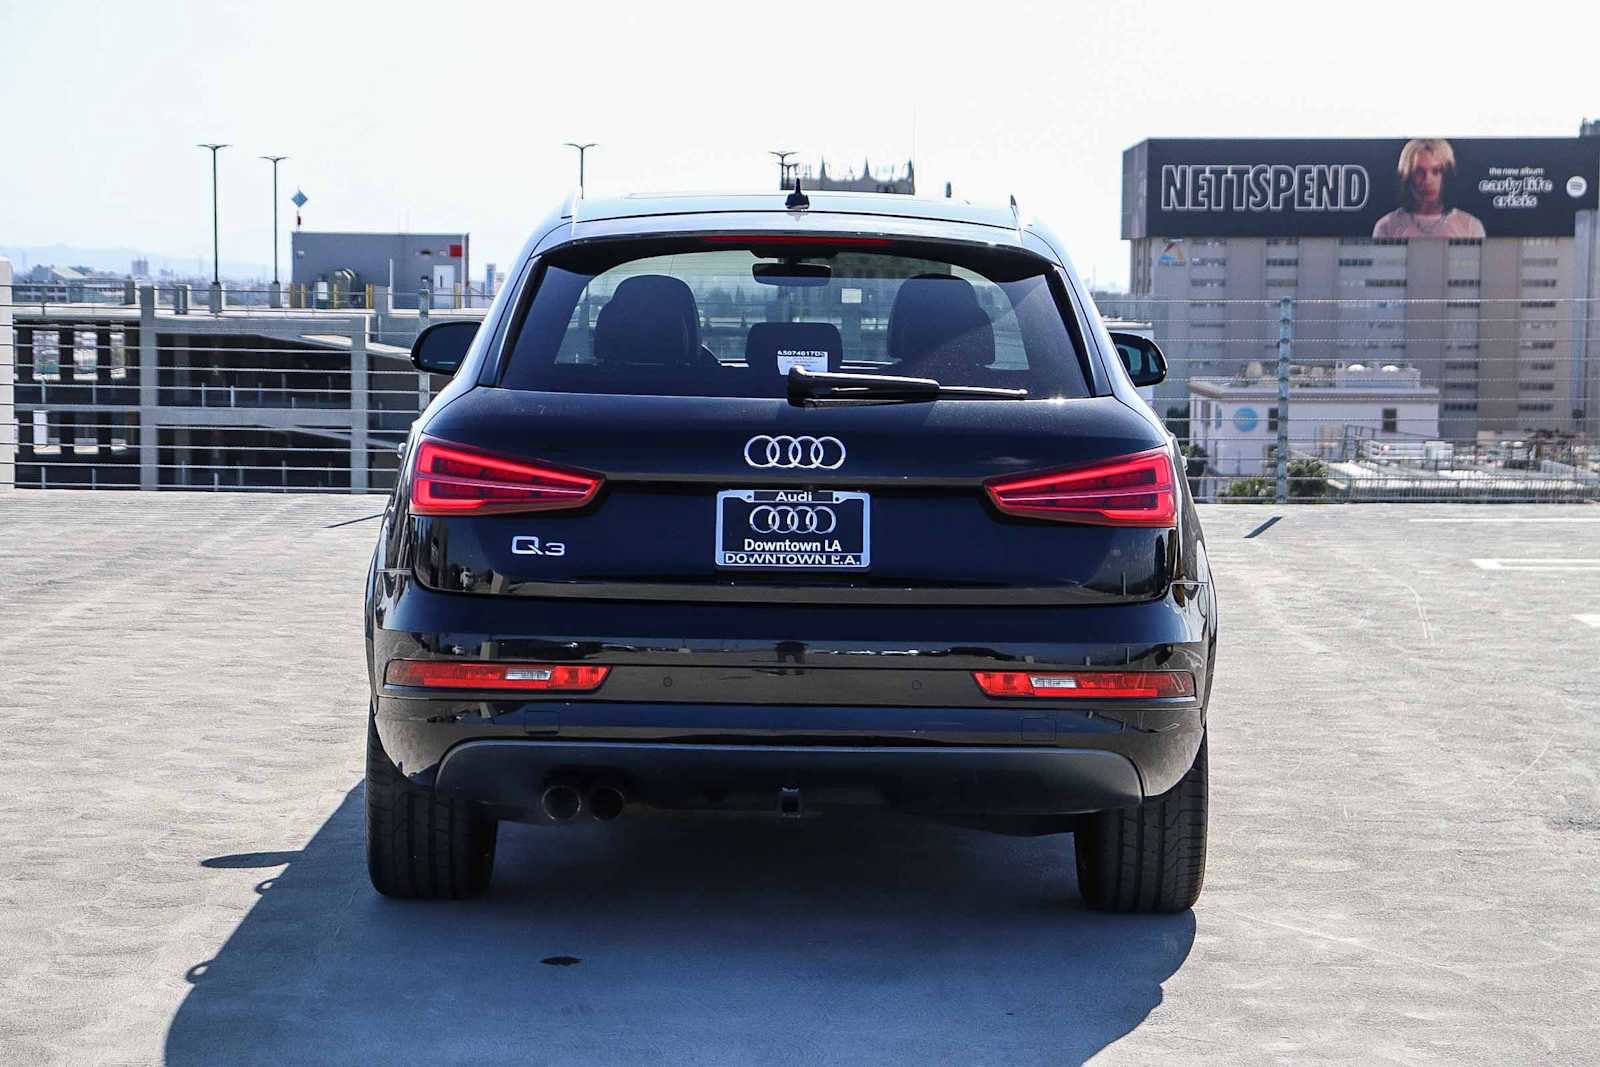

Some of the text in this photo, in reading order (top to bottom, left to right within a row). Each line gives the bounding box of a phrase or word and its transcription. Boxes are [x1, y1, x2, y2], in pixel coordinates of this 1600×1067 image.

[1489, 167, 1544, 177] the new album
[1161, 164, 1370, 210] NETTSPEND
[775, 491, 813, 502] Audi
[511, 535, 566, 557] Q3
[743, 538, 842, 552] Downtown LA
[725, 553, 826, 565] DOWNTOWN
